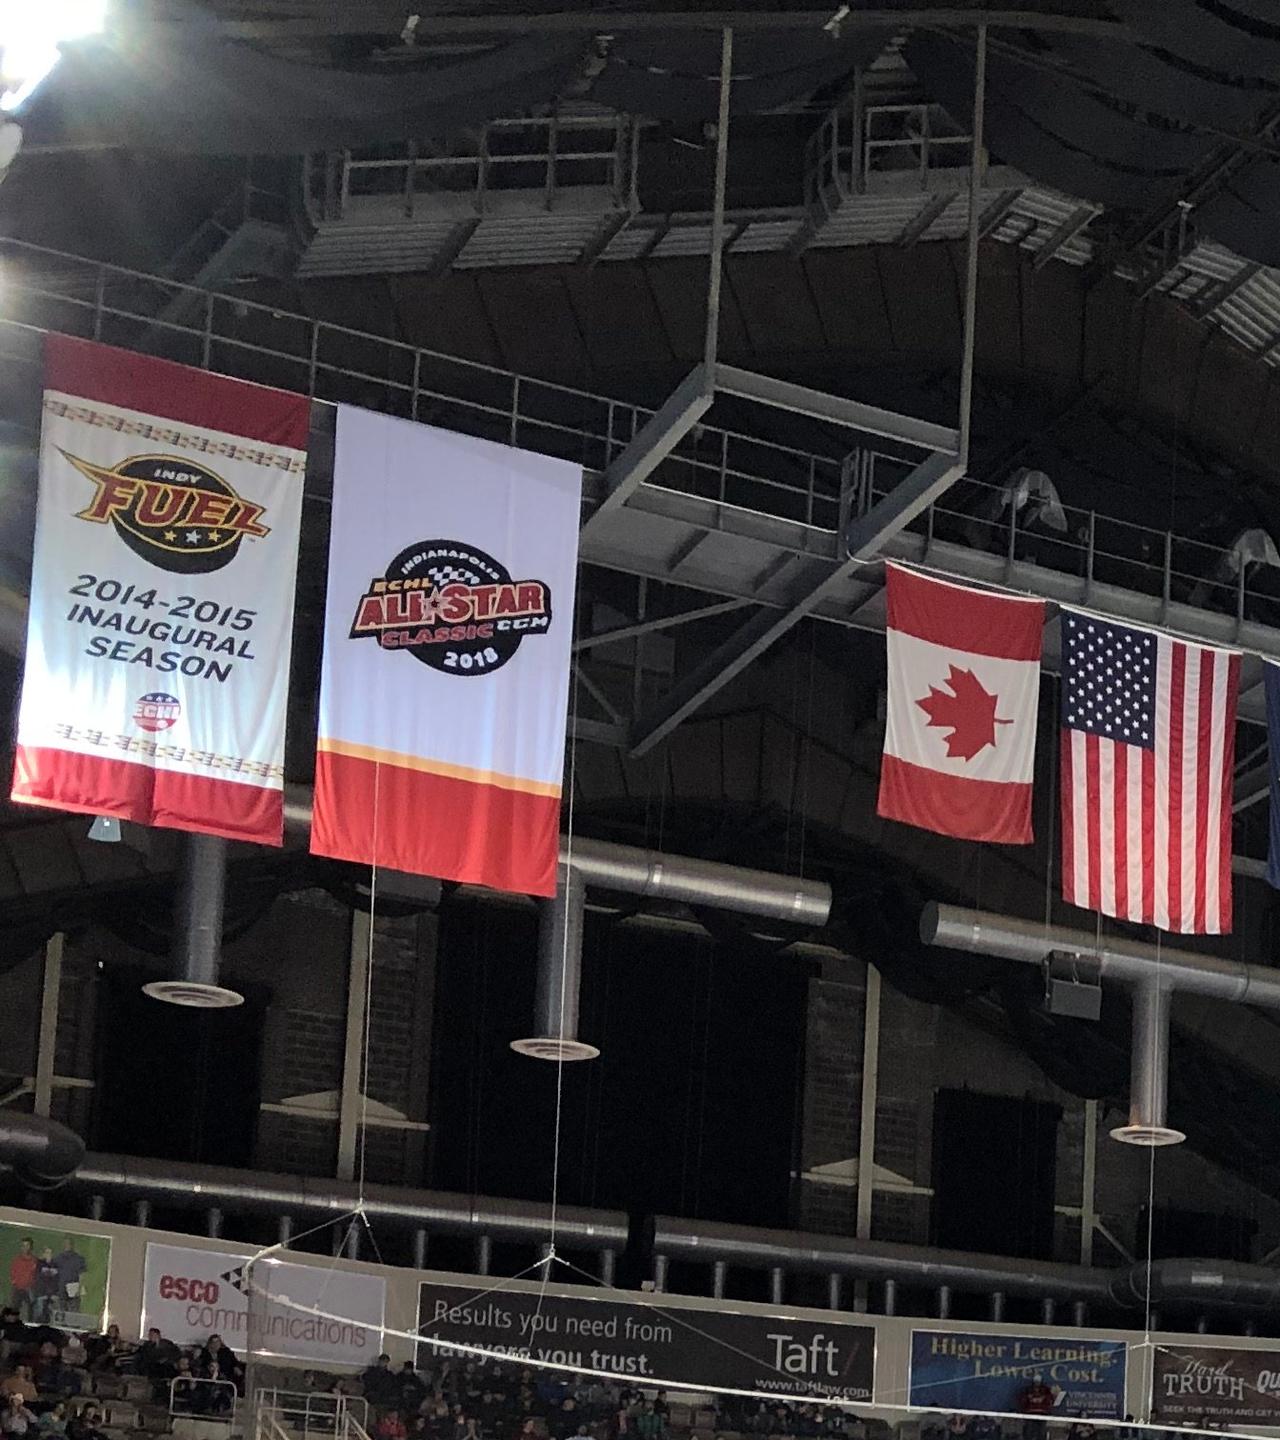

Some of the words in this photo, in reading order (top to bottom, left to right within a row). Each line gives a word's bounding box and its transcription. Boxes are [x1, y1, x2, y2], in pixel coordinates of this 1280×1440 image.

[153, 468, 203, 485] INDY
[74, 468, 273, 538] FUEL
[400, 548, 501, 581] INDIANAPOLIS
[372, 577, 433, 593] ECHL
[68, 573, 258, 632] 2014-2015
[67, 603, 256, 660] INAUGURAL
[382, 623, 494, 647] CLASSIC
[84, 635, 234, 684] SEASON
[443, 646, 499, 669] 2018
[159, 1274, 219, 1305] esco
[186, 1304, 367, 1348] communications
[434, 1301, 512, 1332] Results
[519, 1310, 558, 1334] you
[565, 1317, 617, 1341] need
[623, 1318, 673, 1344] from
[538, 1347, 583, 1371] you
[590, 1348, 655, 1375] trust.
[766, 1333, 839, 1377] Taft
[931, 1335, 1008, 1363] Higher
[1013, 1339, 1118, 1367] Learning.
[1183, 1354, 1235, 1376] Hard
[974, 1360, 1042, 1381] Lower
[1049, 1363, 1104, 1384] Cost.
[754, 1376, 870, 1399] www.taftlaw.com
[1162, 1373, 1245, 1401] TRUTH
[1205, 1407, 1234, 1416] TRUTH
[1235, 1408, 1254, 1416] AND
